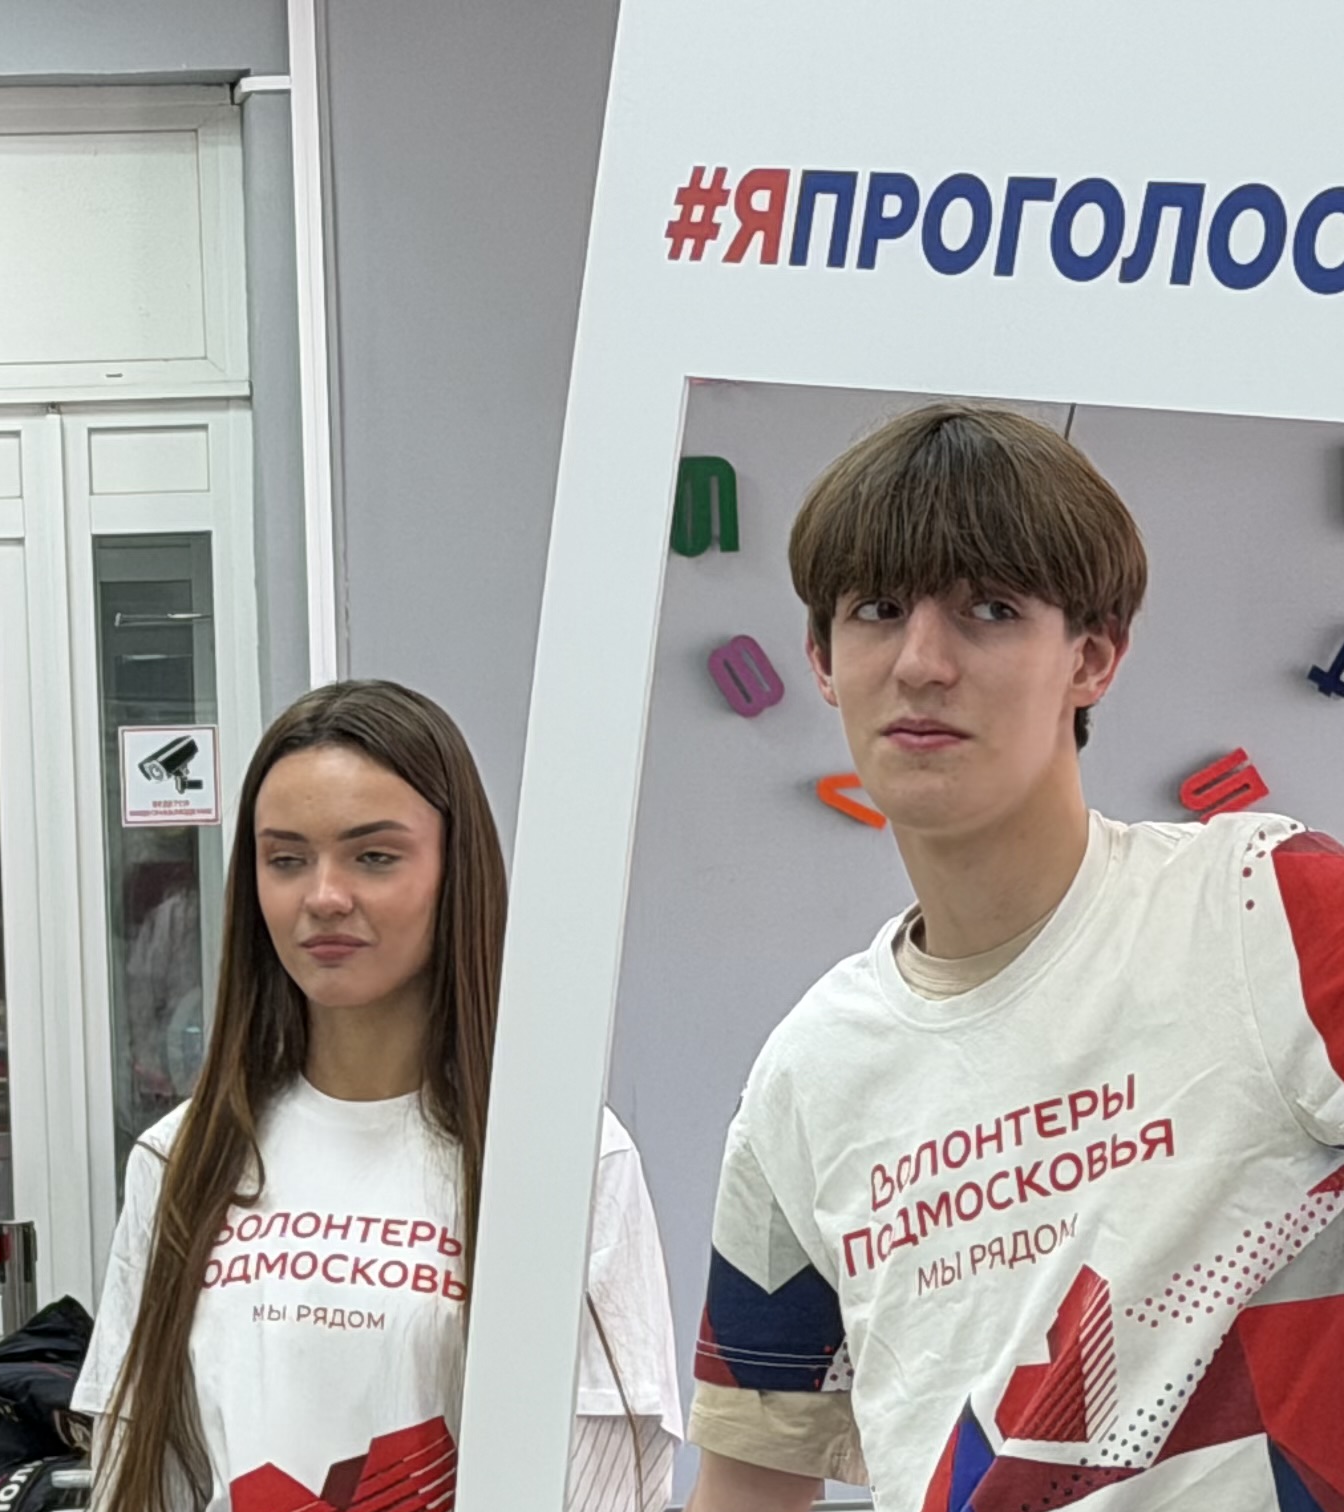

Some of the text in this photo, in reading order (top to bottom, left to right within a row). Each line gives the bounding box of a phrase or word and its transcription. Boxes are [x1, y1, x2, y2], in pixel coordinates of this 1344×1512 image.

[870, 1073, 1135, 1212] ВОЛОНТЕРЫ
[842, 1118, 1175, 1278] ПОДМОСКОВЬЯ
[202, 1250, 469, 1302] ОДМОСКОВЬ
[917, 1212, 1079, 1296] МЫ РЯДОМ
[252, 1304, 386, 1331] МЫ РЯДОМ
